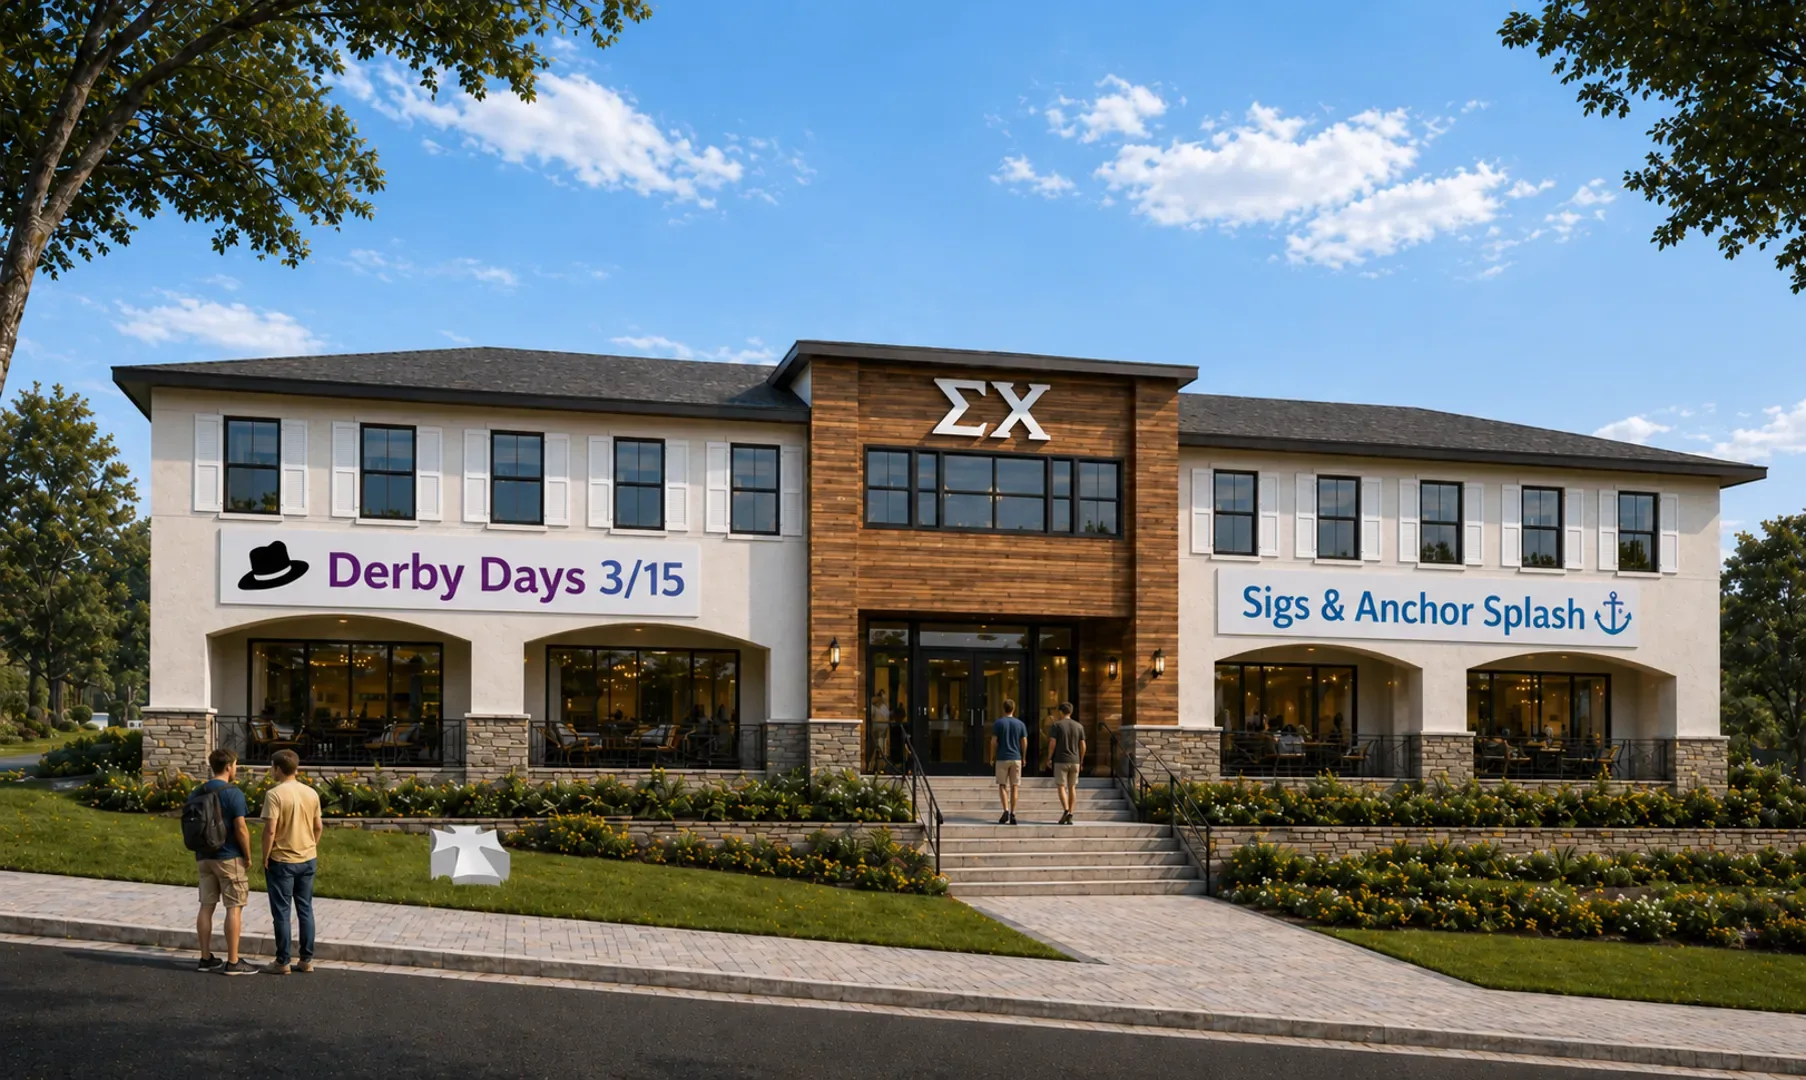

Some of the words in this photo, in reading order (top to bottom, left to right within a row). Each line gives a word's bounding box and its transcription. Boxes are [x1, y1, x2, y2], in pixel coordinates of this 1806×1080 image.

[328, 551, 465, 601] Derby
[480, 556, 586, 603] Days
[599, 559, 685, 599] 3/15
[1242, 585, 1310, 629] Sigs
[1321, 588, 1345, 622] &
[1354, 590, 1475, 626] Anchor
[1483, 595, 1585, 635] Splash
